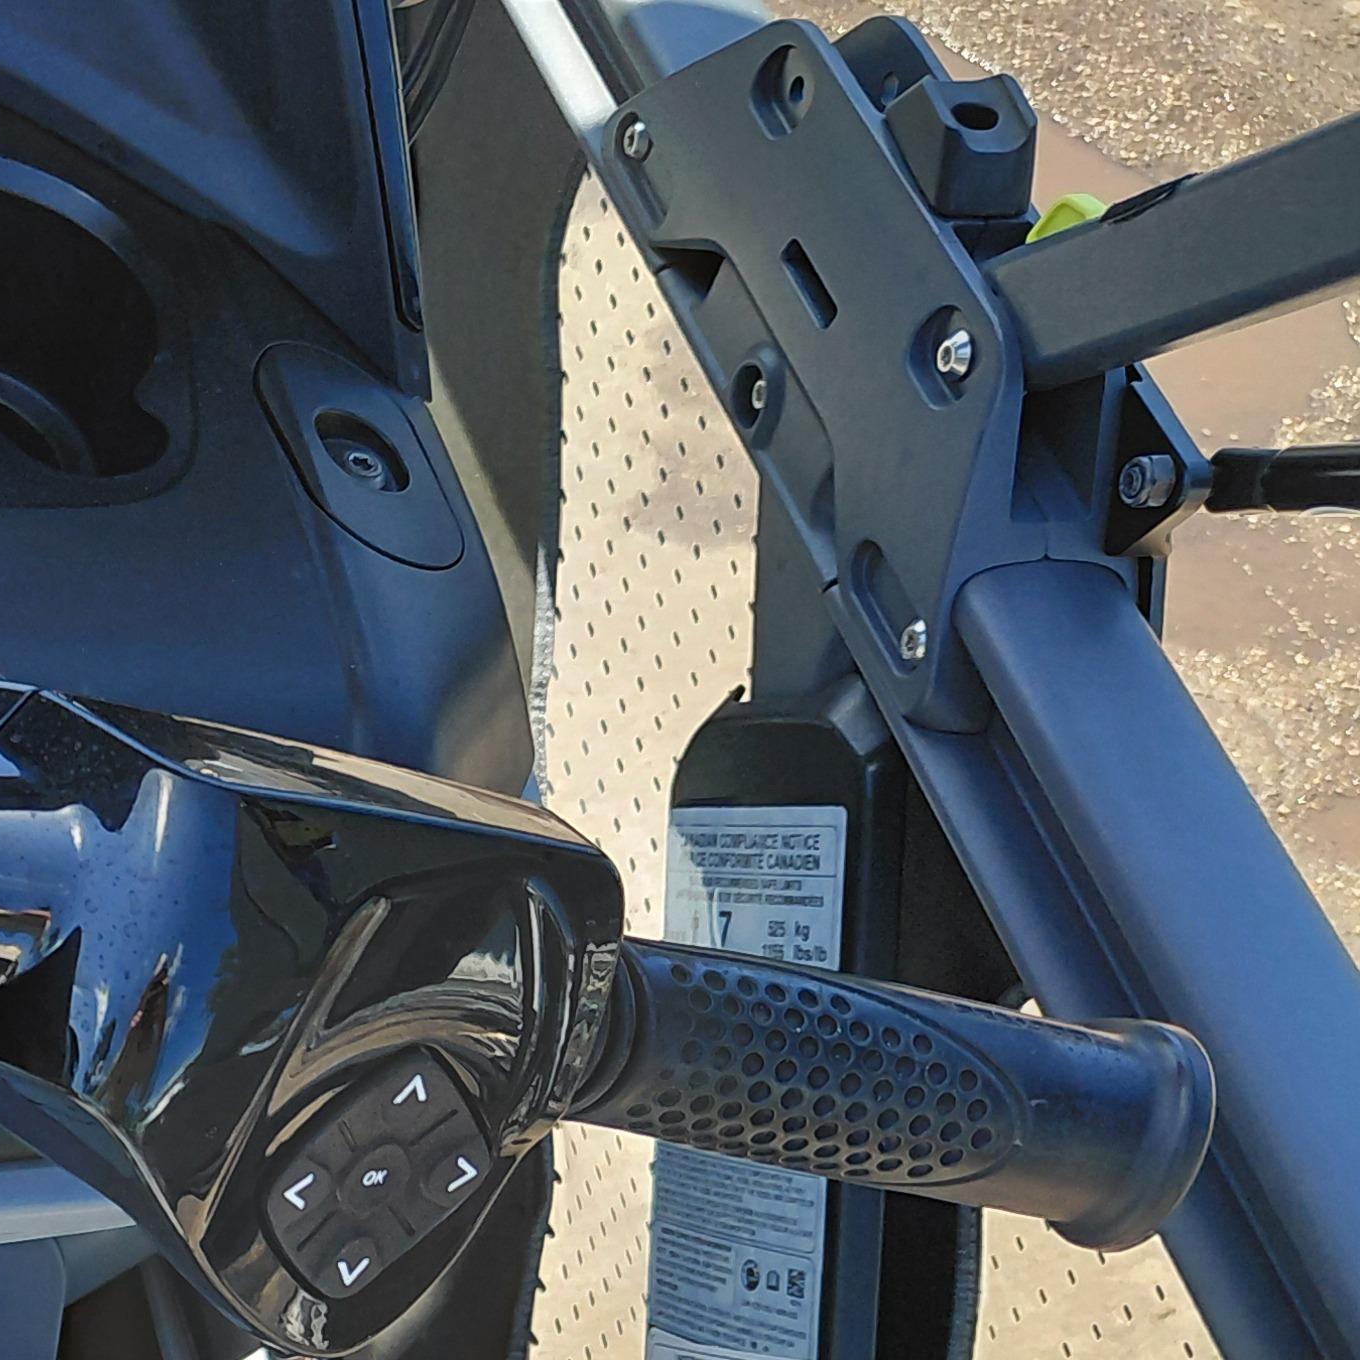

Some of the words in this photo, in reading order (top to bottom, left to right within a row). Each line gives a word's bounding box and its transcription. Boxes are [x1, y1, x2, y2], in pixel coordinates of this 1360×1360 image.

[719, 911, 732, 947] 7
[794, 921, 810, 942] kg
[362, 1169, 388, 1187] OK
